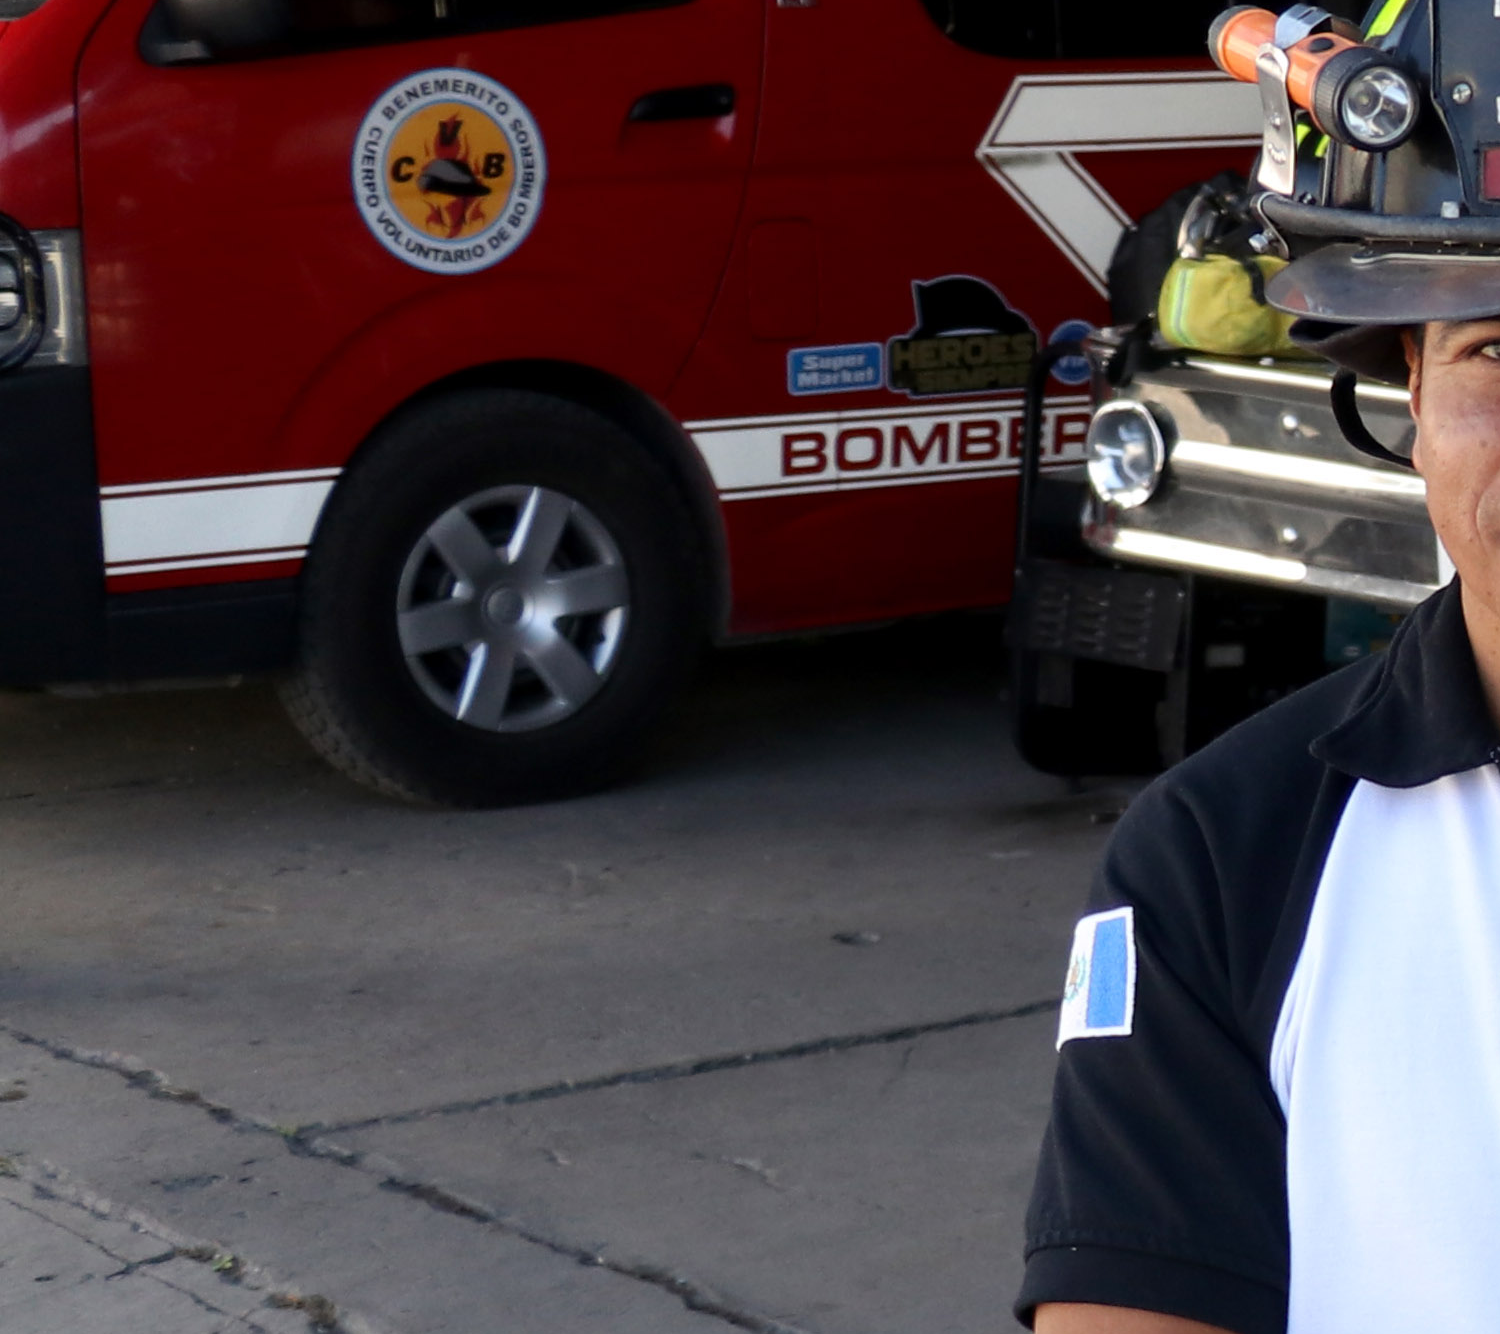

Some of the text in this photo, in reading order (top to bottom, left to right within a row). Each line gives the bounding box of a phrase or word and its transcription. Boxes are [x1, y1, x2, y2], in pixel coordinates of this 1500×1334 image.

[381, 78, 510, 121] BENEMERITO
[361, 126, 383, 209] CUERPO
[391, 120, 506, 183] C V B
[376, 211, 487, 264] VOLUNTARIO
[487, 226, 511, 250] DE
[802, 353, 866, 371] Super
[893, 333, 1037, 367] HEROES
[796, 368, 876, 389] Market
